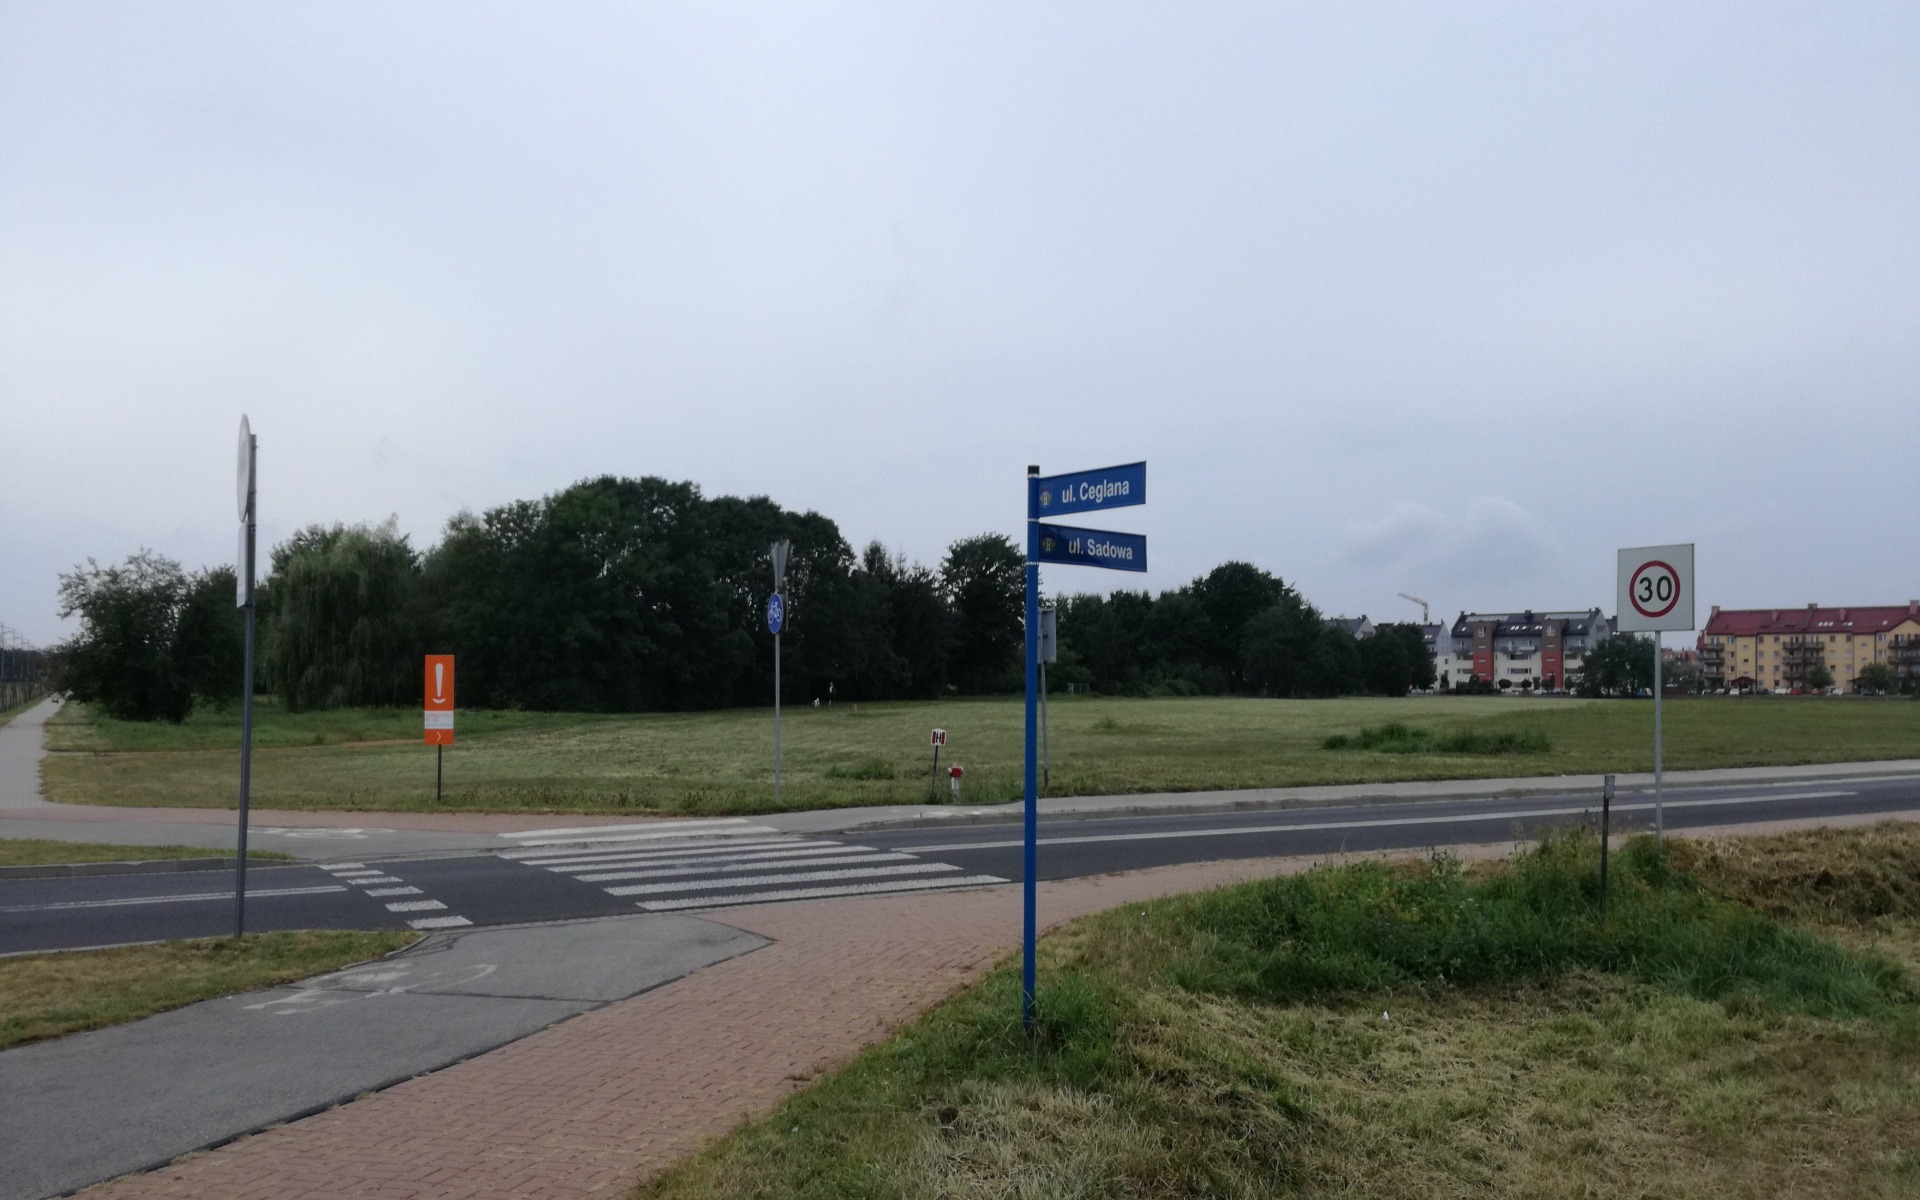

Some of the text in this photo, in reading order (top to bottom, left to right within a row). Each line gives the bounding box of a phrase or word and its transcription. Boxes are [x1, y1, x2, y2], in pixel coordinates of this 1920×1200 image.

[1062, 479, 1130, 503] ul. Ceglana
[1068, 538, 1133, 560] ul. Sadowa
[1638, 575, 1672, 602] 30
[936, 732, 942, 743] H
